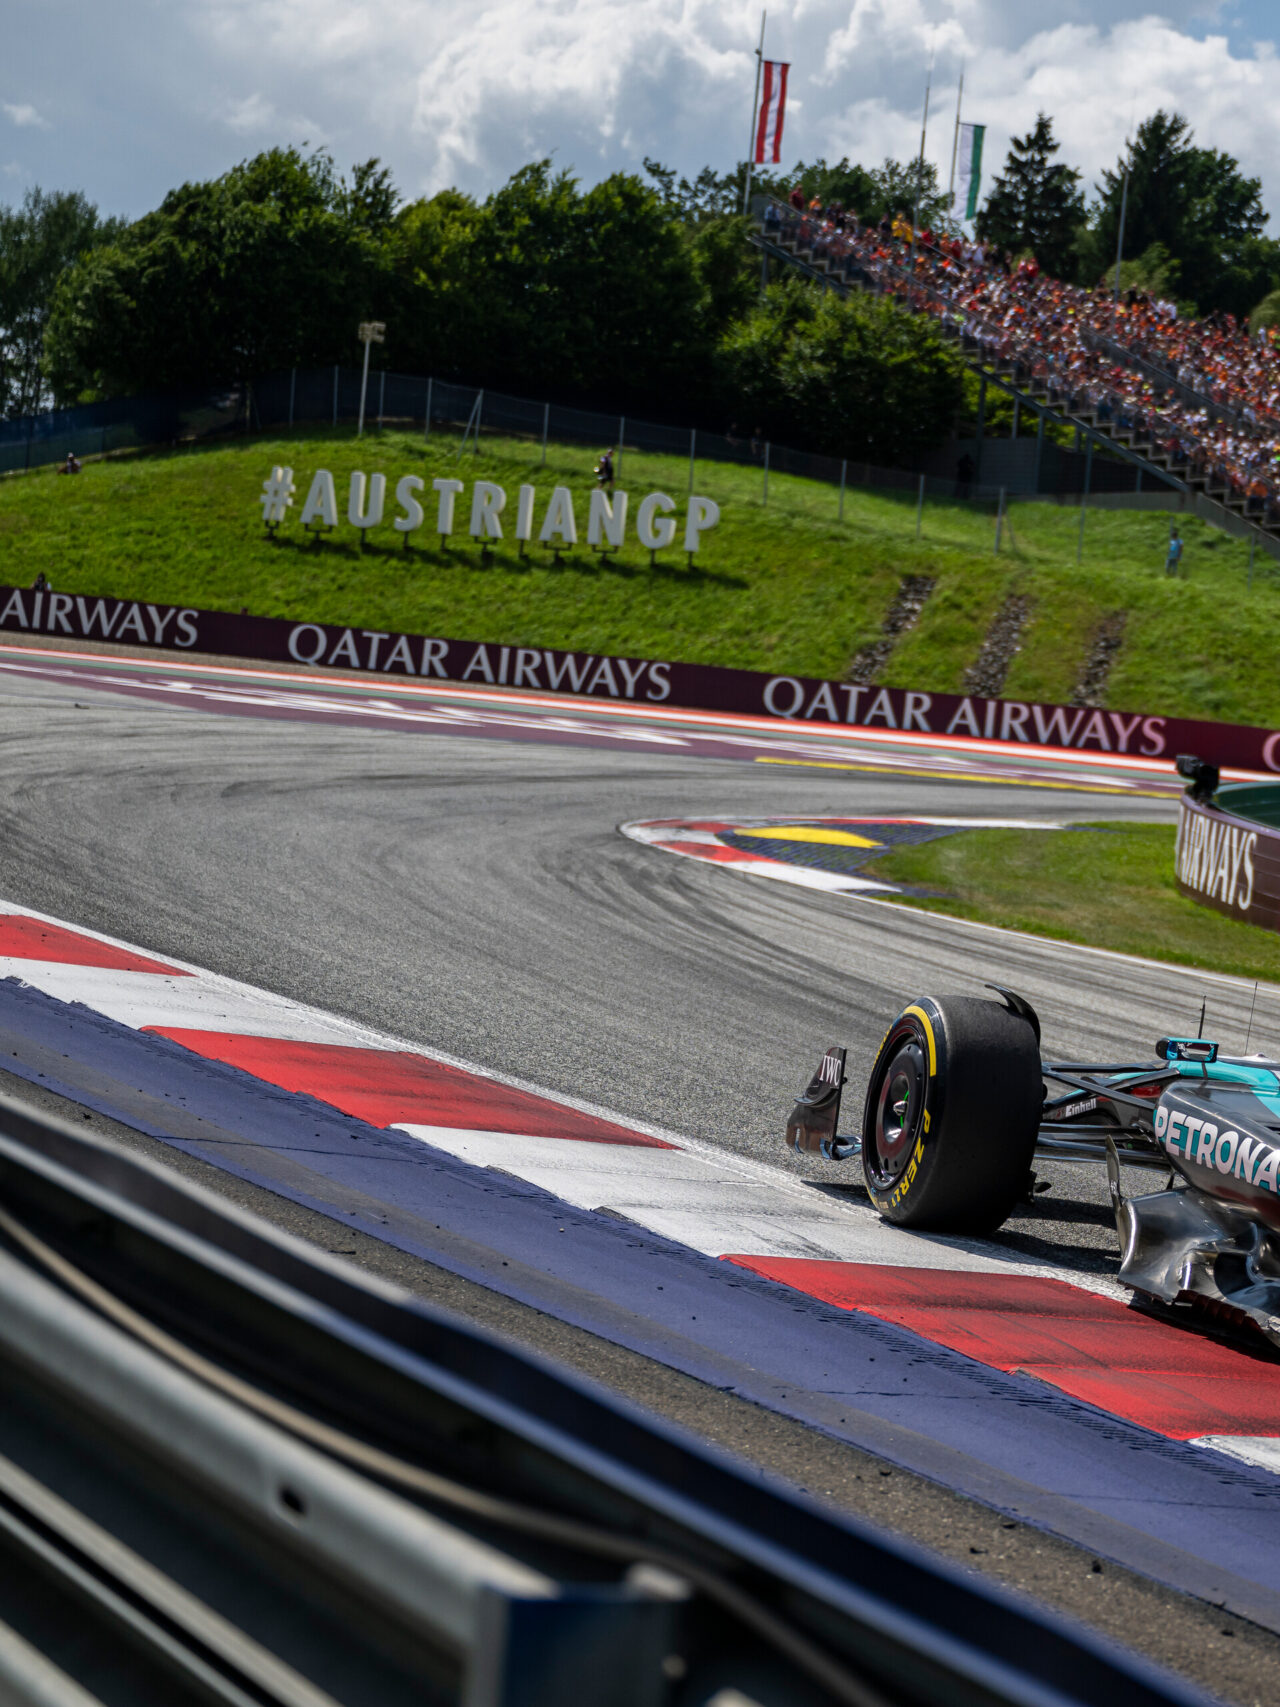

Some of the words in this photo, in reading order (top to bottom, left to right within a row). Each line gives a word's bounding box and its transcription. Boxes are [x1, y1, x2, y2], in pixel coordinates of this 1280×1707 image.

[262, 466, 720, 552] #AUSTRIANGP
[0, 589, 199, 647] AIRWAYS
[288, 624, 449, 679] QATAR
[463, 647, 671, 700] AIRWAYS
[763, 677, 932, 731] QATAR
[946, 698, 1167, 756] AIRWAYS
[819, 1055, 842, 1086] IWC
[1065, 1098, 1097, 1118] Einhell
